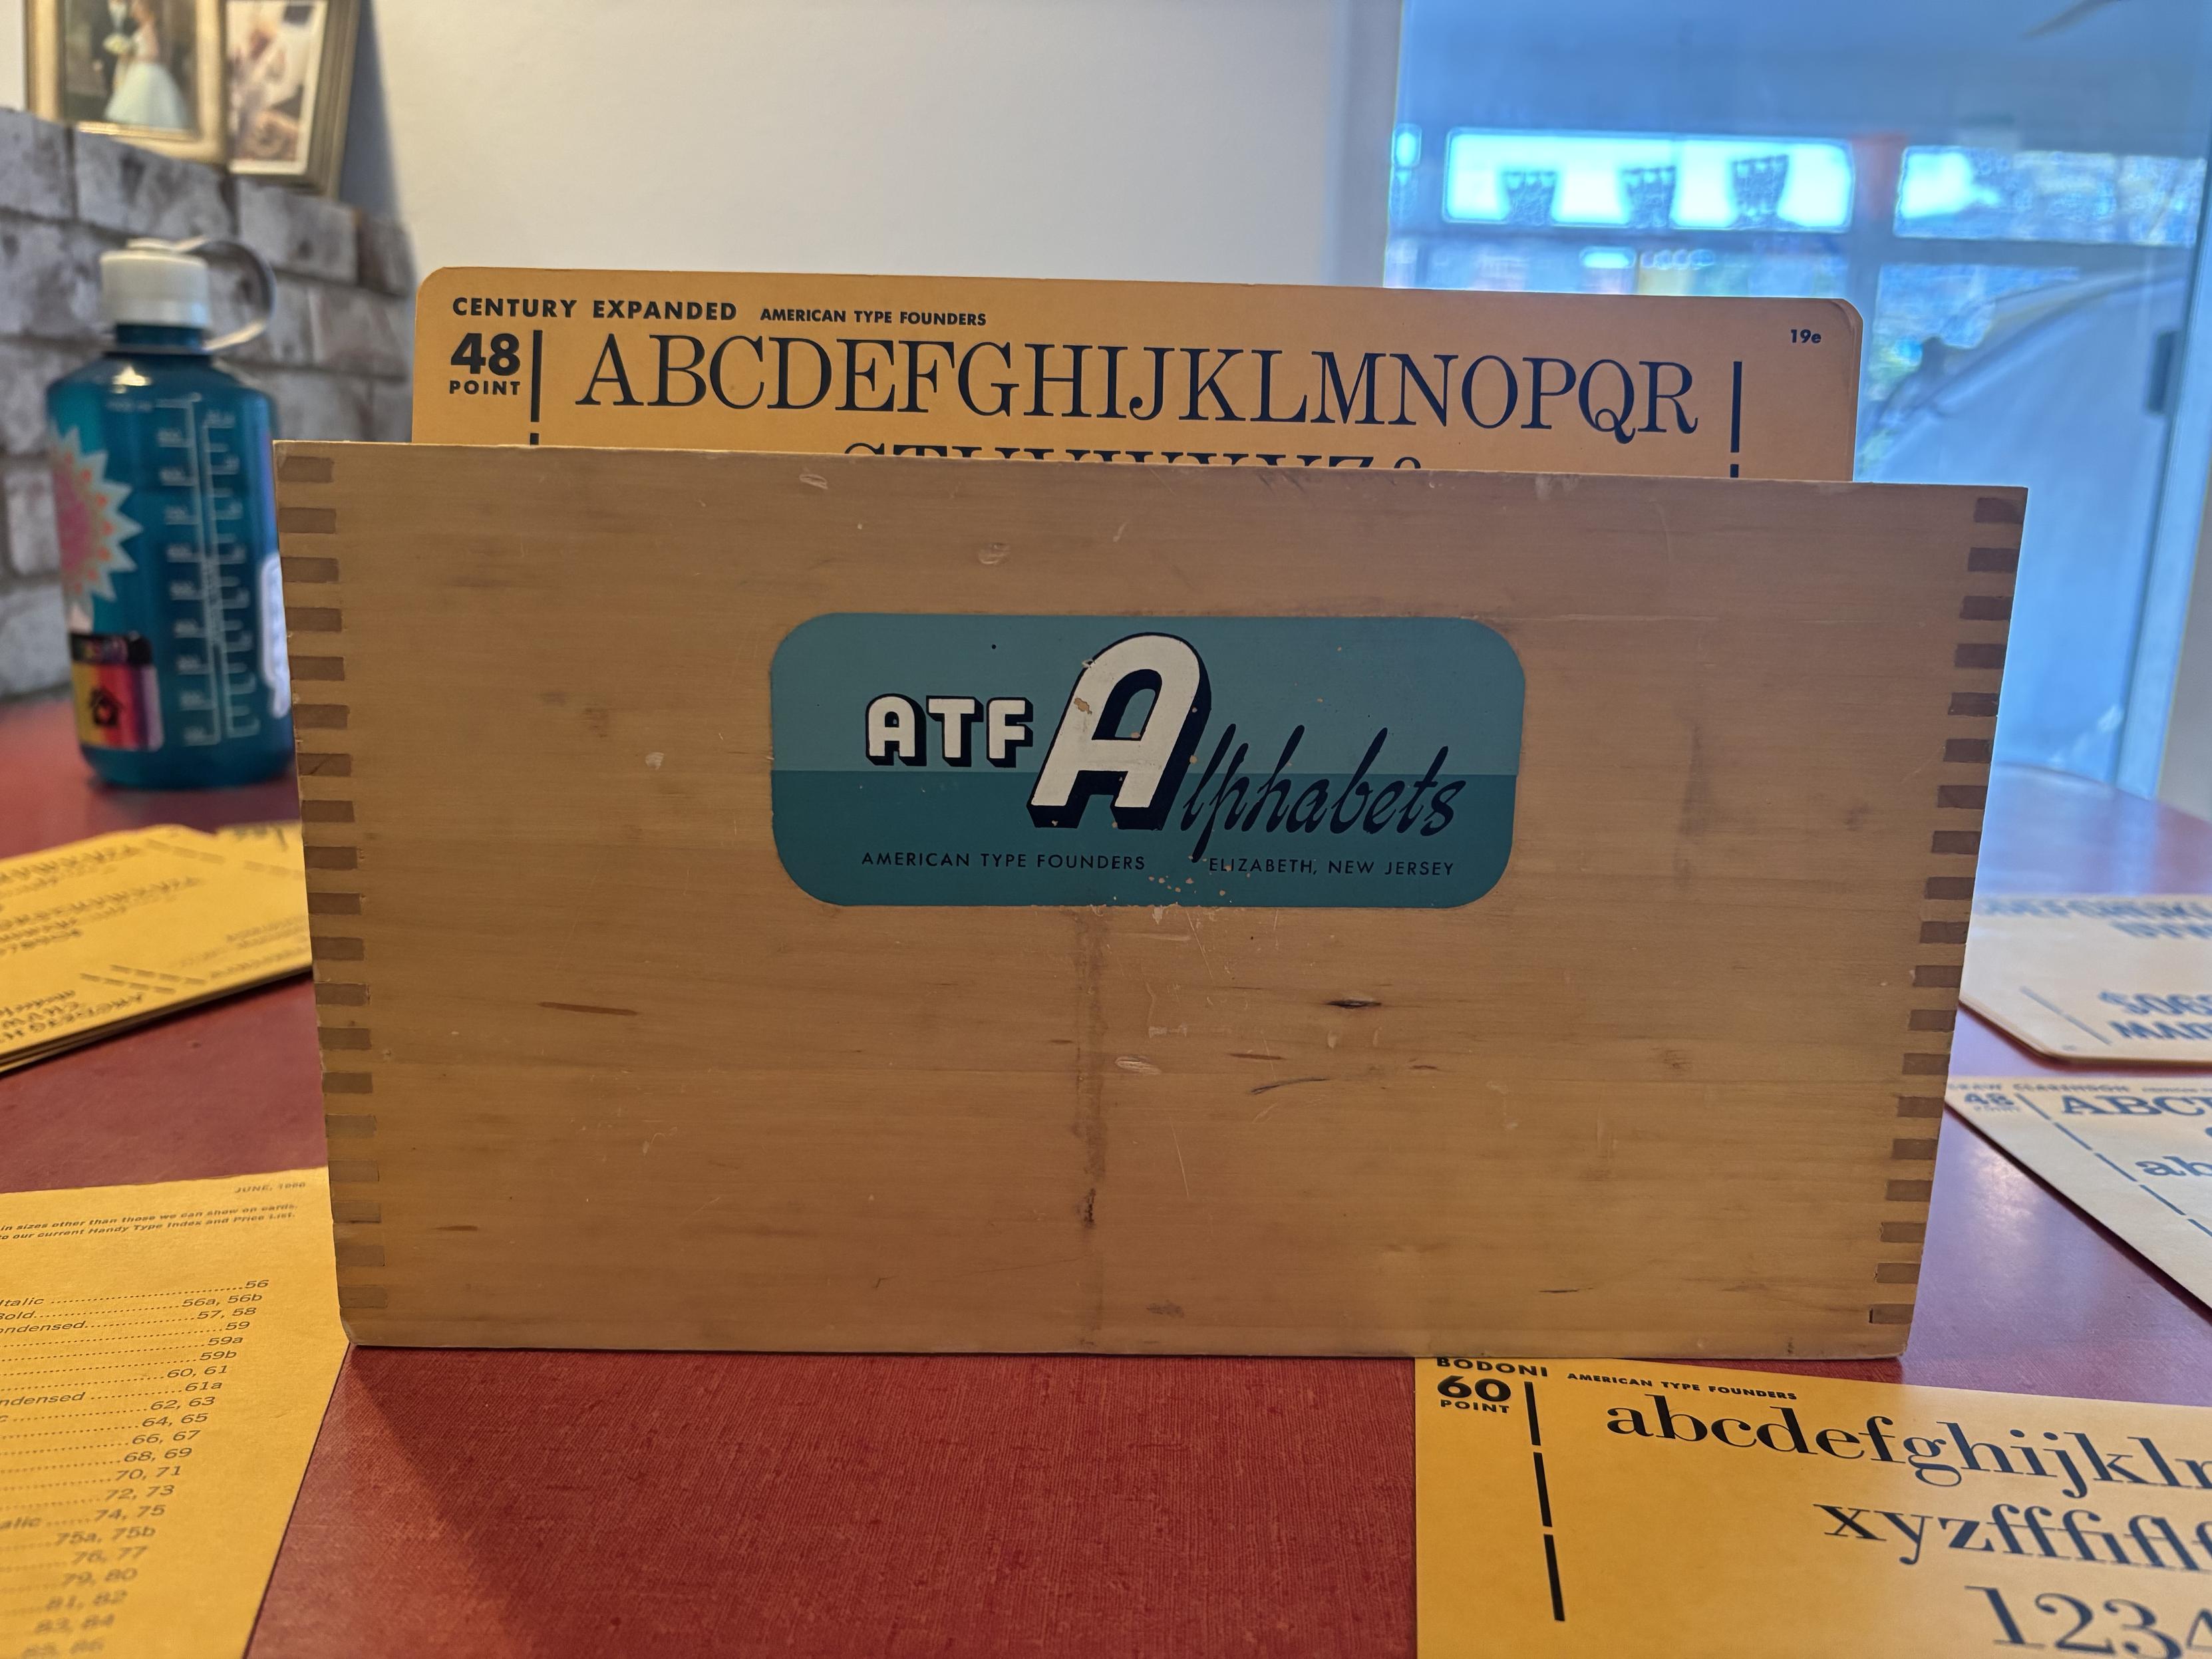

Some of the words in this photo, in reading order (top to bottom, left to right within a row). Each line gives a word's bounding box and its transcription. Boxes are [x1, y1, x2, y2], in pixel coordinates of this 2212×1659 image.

[452, 297, 577, 318] CENTURY
[593, 299, 737, 321] EXPANDED
[760, 308, 846, 323] AMERICAN
[854, 311, 892, 323] TYPE
[900, 311, 987, 326] FOUNDERS
[1790, 329, 1821, 344] 19e
[450, 333, 521, 377] 48
[449, 380, 521, 395] POINT
[575, 333, 1698, 444] ABCDEFGHIJKLMNOPQR
[866, 693, 1034, 768] ATF
[1027, 631, 1466, 863] Alphabets
[862, 852, 970, 867] AMERICAN
[981, 853, 1027, 868] TYPE
[1036, 854, 1145, 870] FOUNDERS
[1209, 857, 1317, 875] ELIZABETH,
[1328, 861, 1374, 874] NEW
[1384, 862, 1454, 875] JERSEY
[206, 1207, 238, 1216] show
[37, 1229, 84, 1237] current
[88, 1225, 129, 1235] Handy
[167, 1219, 202, 1229] Index
[245, 1279, 269, 1288] 56
[182, 1298, 220, 1307] 56a,
[228, 1294, 263, 1304] 56b
[197, 1310, 225, 1319] 57,
[232, 1307, 257, 1316] 58
[225, 1321, 250, 1330] 59
[208, 1336, 243, 1346] 59a
[200, 1350, 237, 1361] 59b
[167, 1368, 197, 1378] 60,
[204, 1365, 228, 1375] 61
[1437, 1357, 1547, 1376] BODONI
[185, 1381, 223, 1392] 61a
[1437, 1375, 1511, 1402] 60
[1567, 1373, 1653, 1386] AMERICAN
[1660, 1382, 1700, 1391] TYPE
[1708, 1386, 1798, 1400] FOUNDERS
[150, 1400, 181, 1410] 62,
[188, 1397, 216, 1407] 63
[1440, 1399, 1509, 1414] POINT
[142, 1416, 173, 1427] 64,
[180, 1413, 208, 1424] 65
[132, 1433, 164, 1444] 66,
[172, 1430, 201, 1441] 67
[124, 1451, 156, 1462] 68,
[164, 1447, 192, 1459] 69
[115, 1469, 147, 1481] 70,
[155, 1465, 181, 1477] 71
[105, 1488, 137, 1501] 72,
[146, 1484, 175, 1497] 73
[94, 1509, 127, 1522] 74,
[137, 1504, 166, 1517] 75
[55, 1532, 102, 1546] 75a,
[112, 1526, 156, 1541] 75b
[117, 1545, 148, 1560] 77
